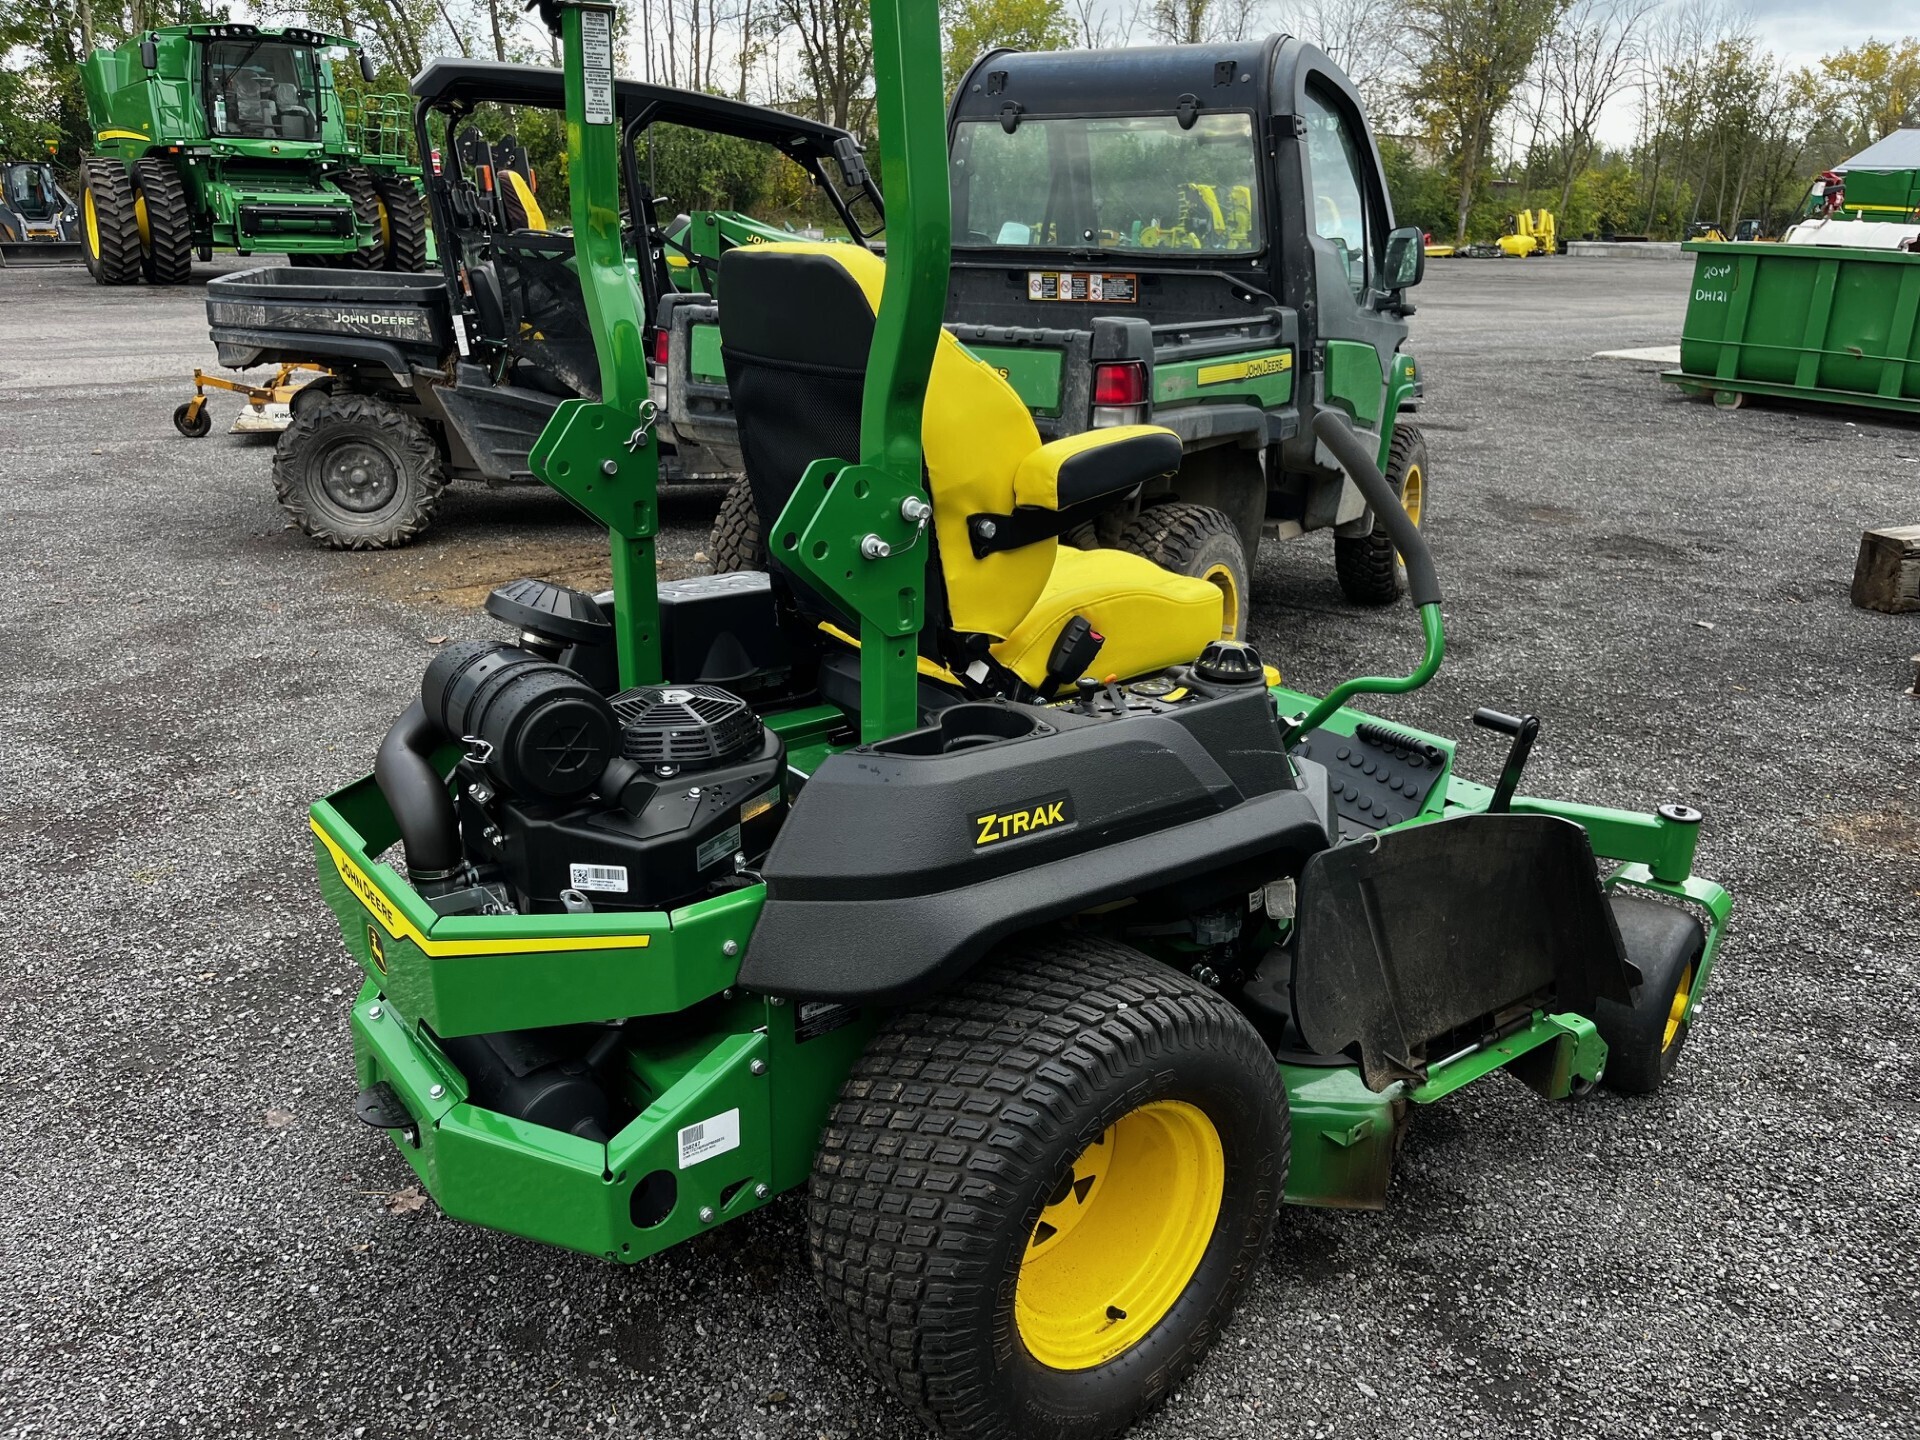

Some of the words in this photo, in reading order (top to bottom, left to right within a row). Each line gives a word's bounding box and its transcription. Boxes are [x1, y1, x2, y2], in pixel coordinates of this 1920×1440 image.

[1695, 288, 1728, 303] DH121
[333, 313, 369, 324] JOHN
[371, 314, 415, 326] DEERE
[1245, 361, 1263, 378] JOHN
[1263, 359, 1284, 375] DEERE
[976, 801, 1065, 845] ZTRAK
[341, 858, 363, 892] JOHN
[363, 881, 395, 927] DEERE
